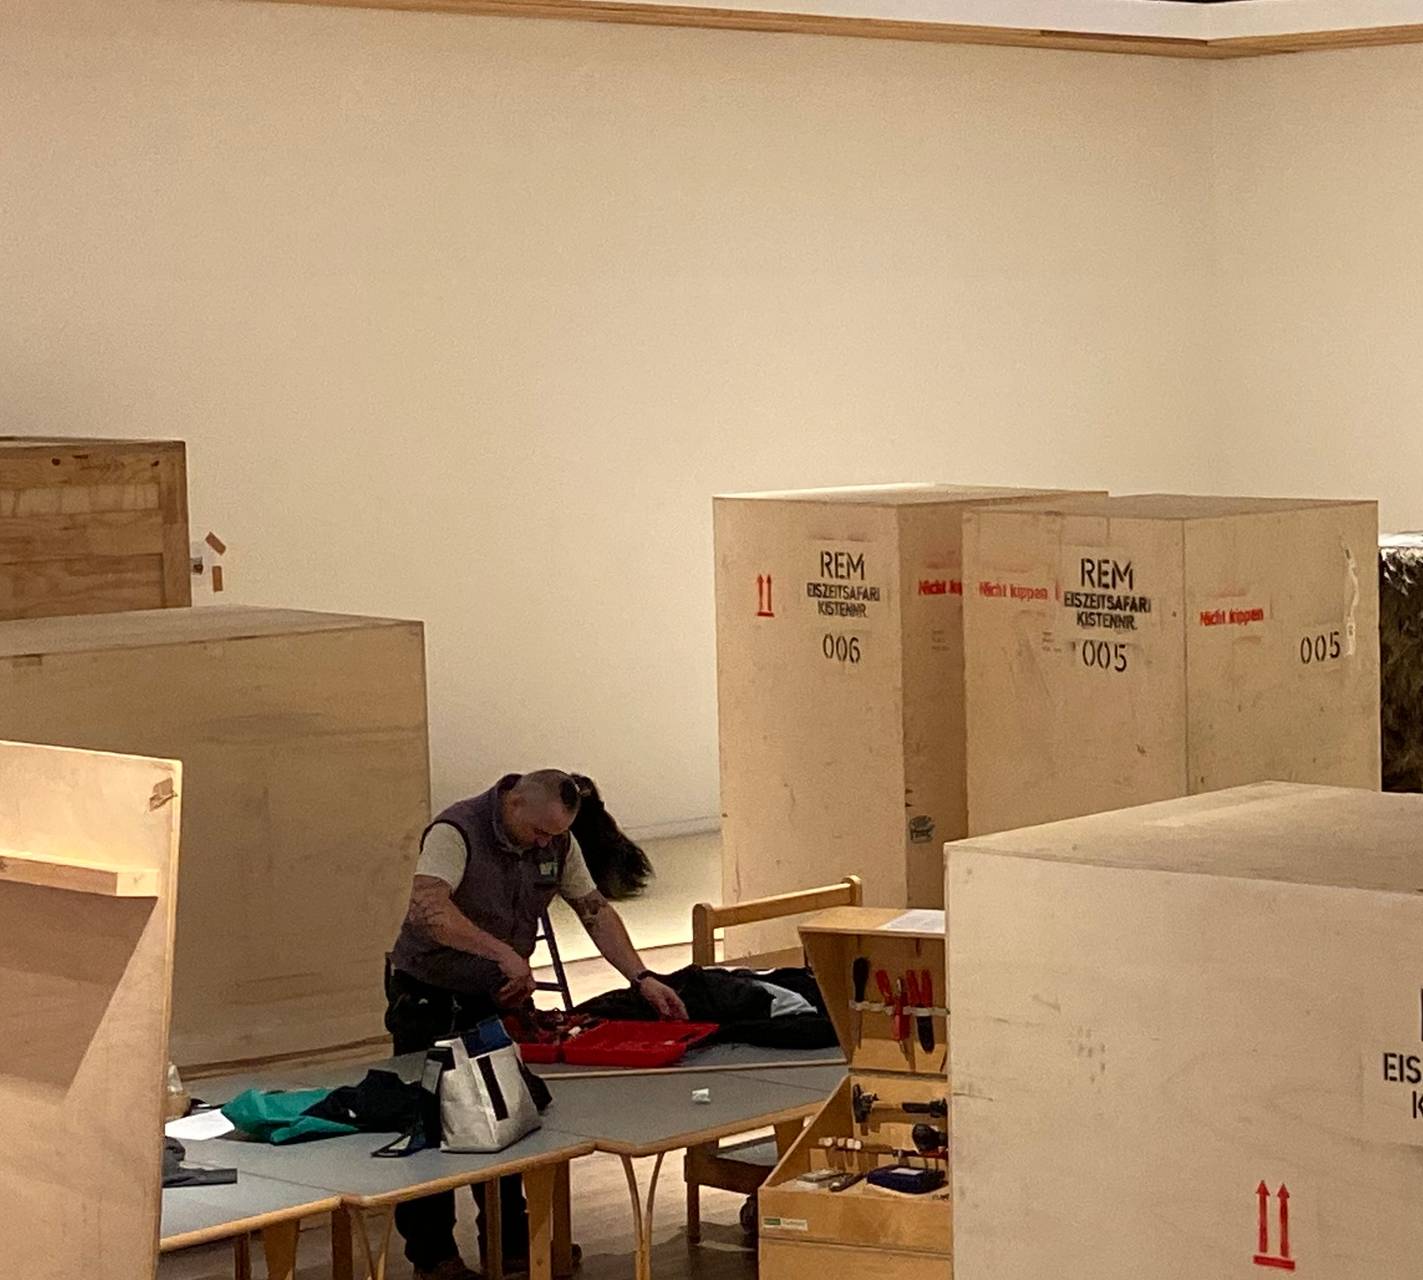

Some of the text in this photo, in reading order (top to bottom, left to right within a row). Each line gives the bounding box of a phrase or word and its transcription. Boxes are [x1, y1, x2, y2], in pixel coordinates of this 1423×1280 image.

[820, 551, 865, 580] REM
[1081, 558, 1134, 590] REM
[806, 582, 880, 601] EISZEITSAFARI
[979, 582, 1006, 598] Nicht
[1064, 591, 1152, 613] EISZEITSAFARI
[823, 633, 861, 663] 006
[1082, 640, 1127, 672] 005
[1300, 631, 1340, 664] 005
